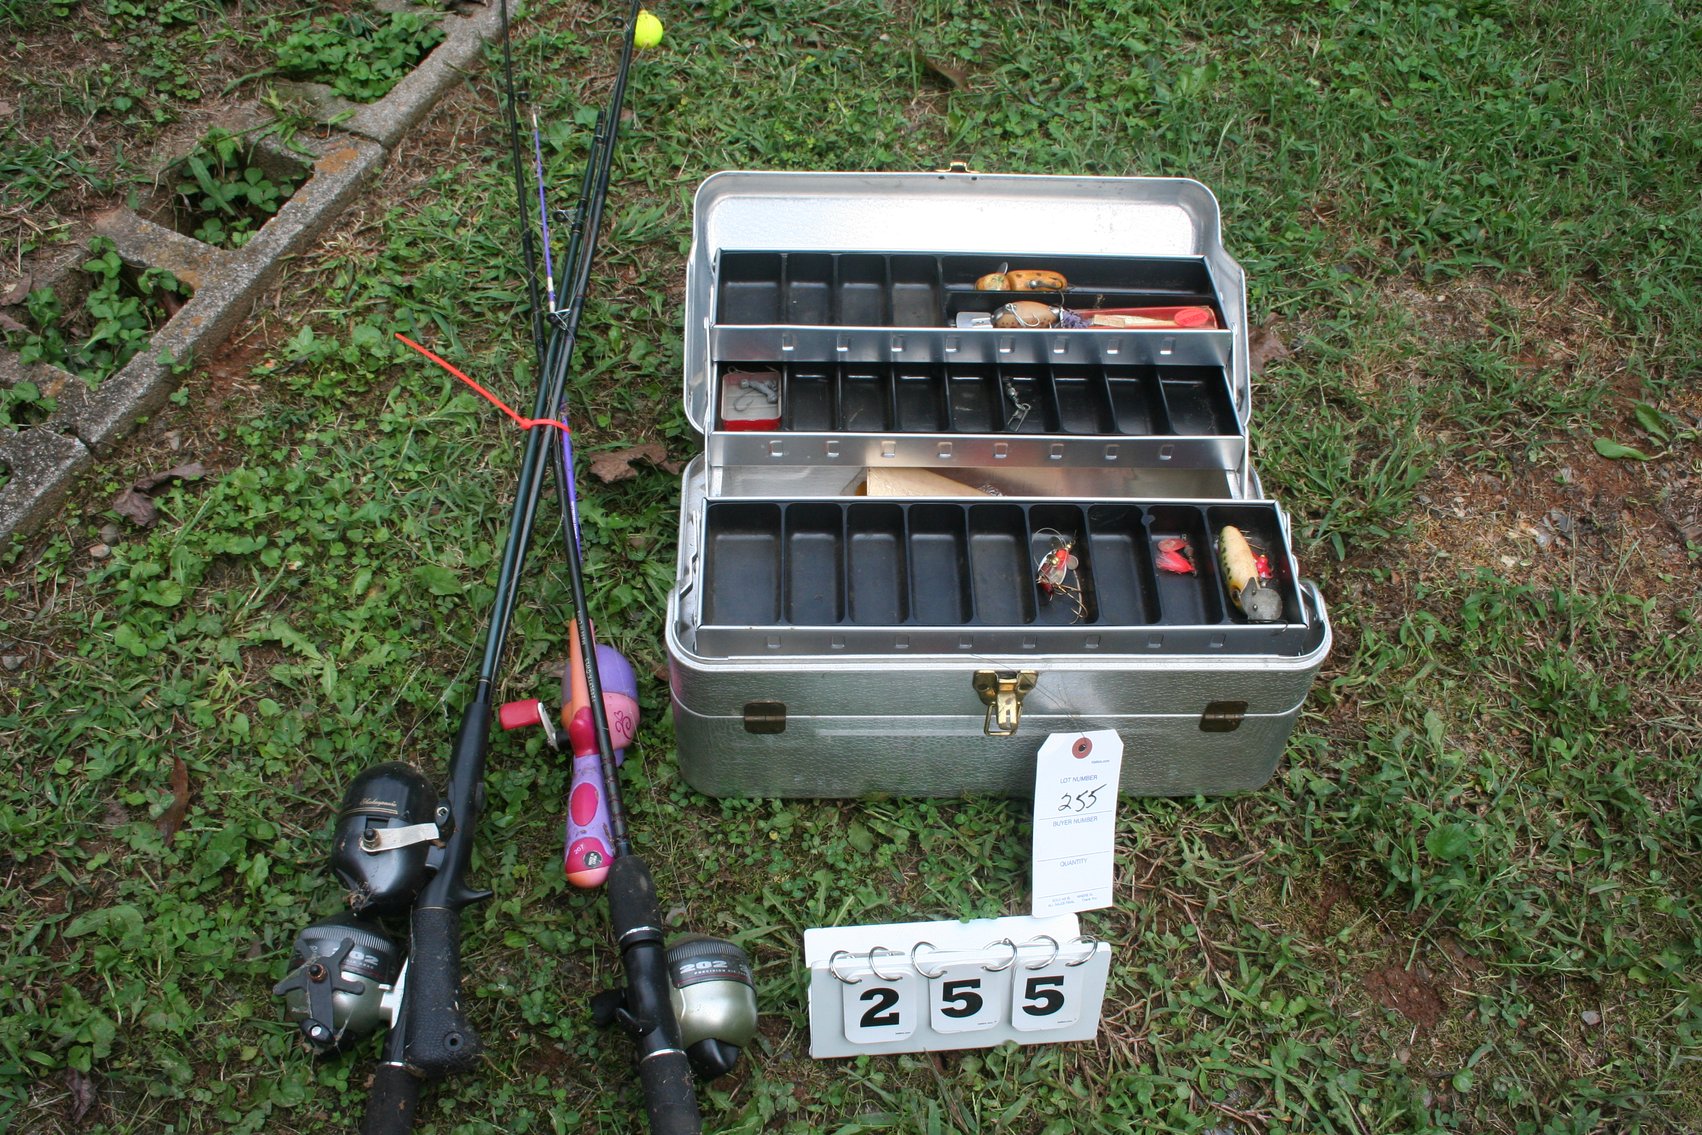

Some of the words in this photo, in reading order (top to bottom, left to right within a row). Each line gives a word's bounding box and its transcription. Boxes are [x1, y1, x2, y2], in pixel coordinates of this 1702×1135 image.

[1072, 775, 1098, 783] NUMBER
[1058, 784, 1107, 812] 255
[1053, 819, 1072, 827] BUYER
[1073, 816, 1098, 825] NUMBER
[1060, 858, 1088, 868] QUANTITY
[680, 960, 728, 974] 202
